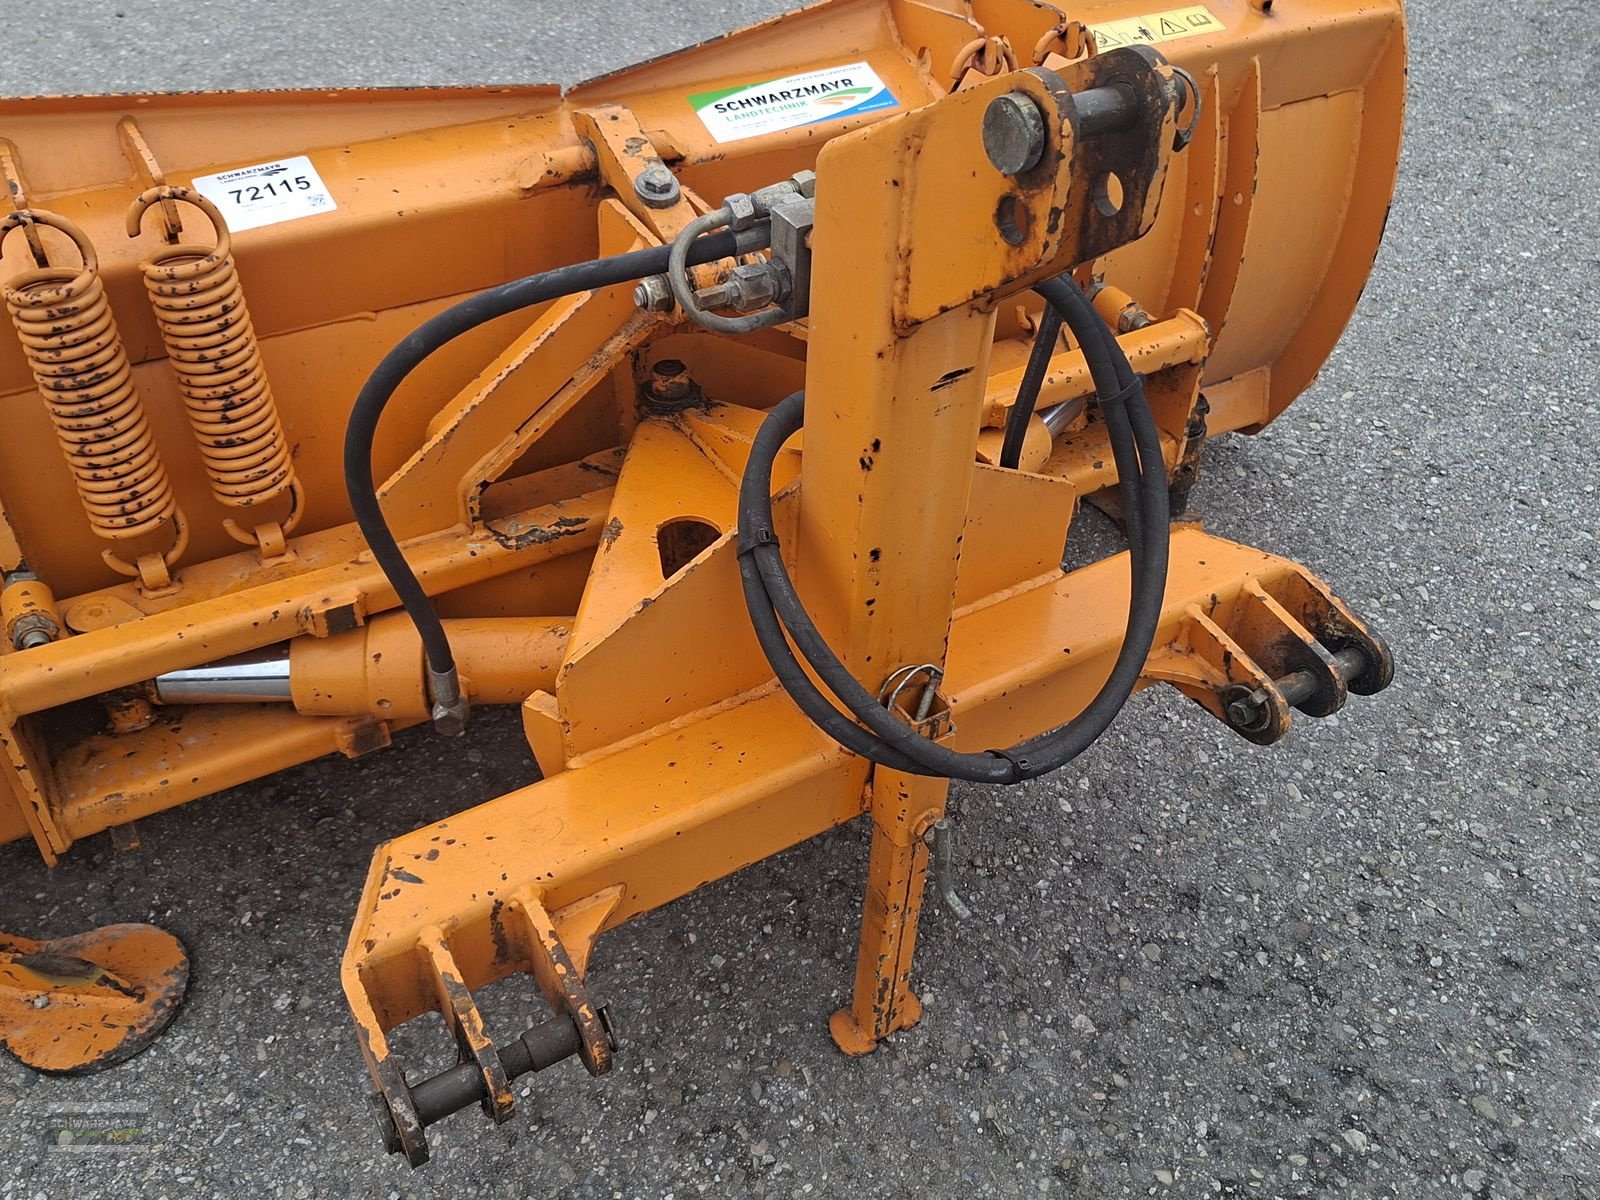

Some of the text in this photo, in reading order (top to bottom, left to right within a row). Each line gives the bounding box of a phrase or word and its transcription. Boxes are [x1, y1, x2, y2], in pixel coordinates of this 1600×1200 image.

[714, 78, 855, 114] SCHWARZMAYR
[725, 100, 808, 122] LANDTECHNIK
[216, 163, 281, 181] SCHWARZMAYR
[227, 175, 311, 204] 72115
